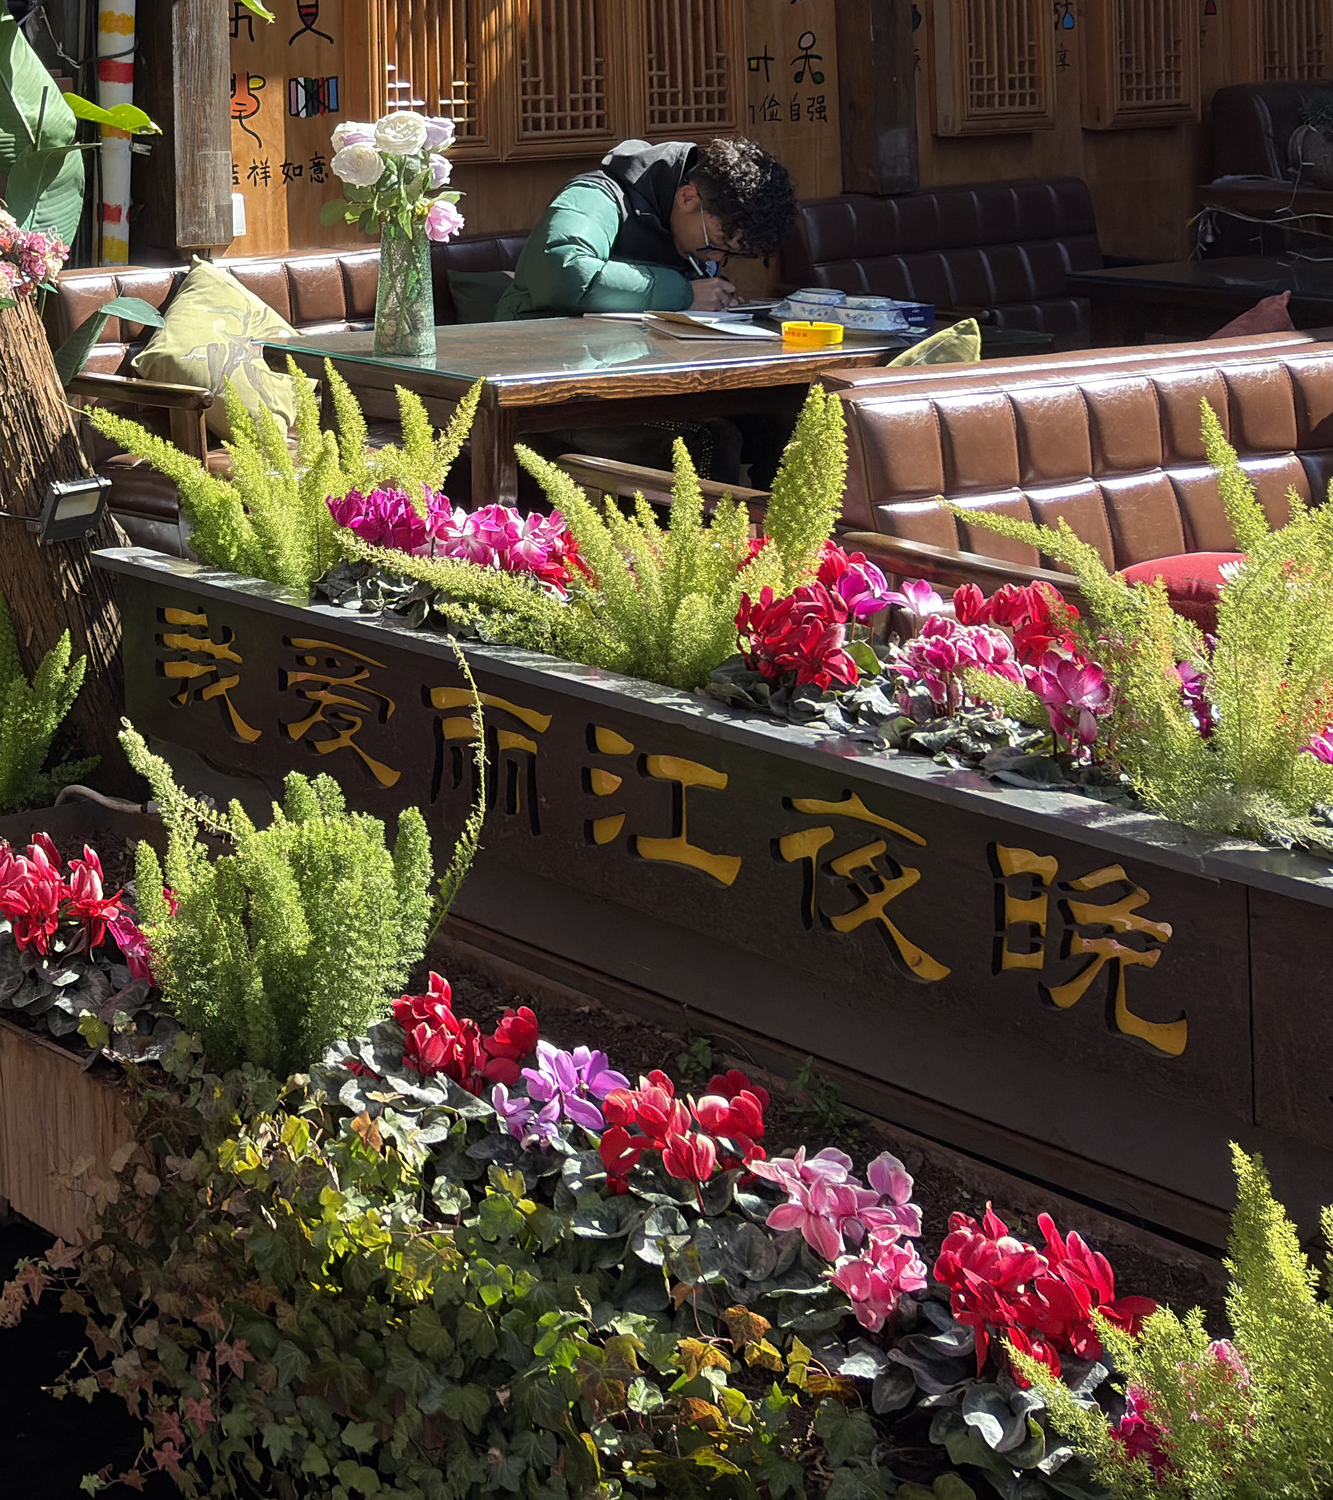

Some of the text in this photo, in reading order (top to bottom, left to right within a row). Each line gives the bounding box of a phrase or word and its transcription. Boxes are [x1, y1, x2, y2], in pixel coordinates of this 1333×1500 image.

[748, 92, 828, 124] 俭自强
[153, 605, 1191, 1058] 我爱丽江夜晚
